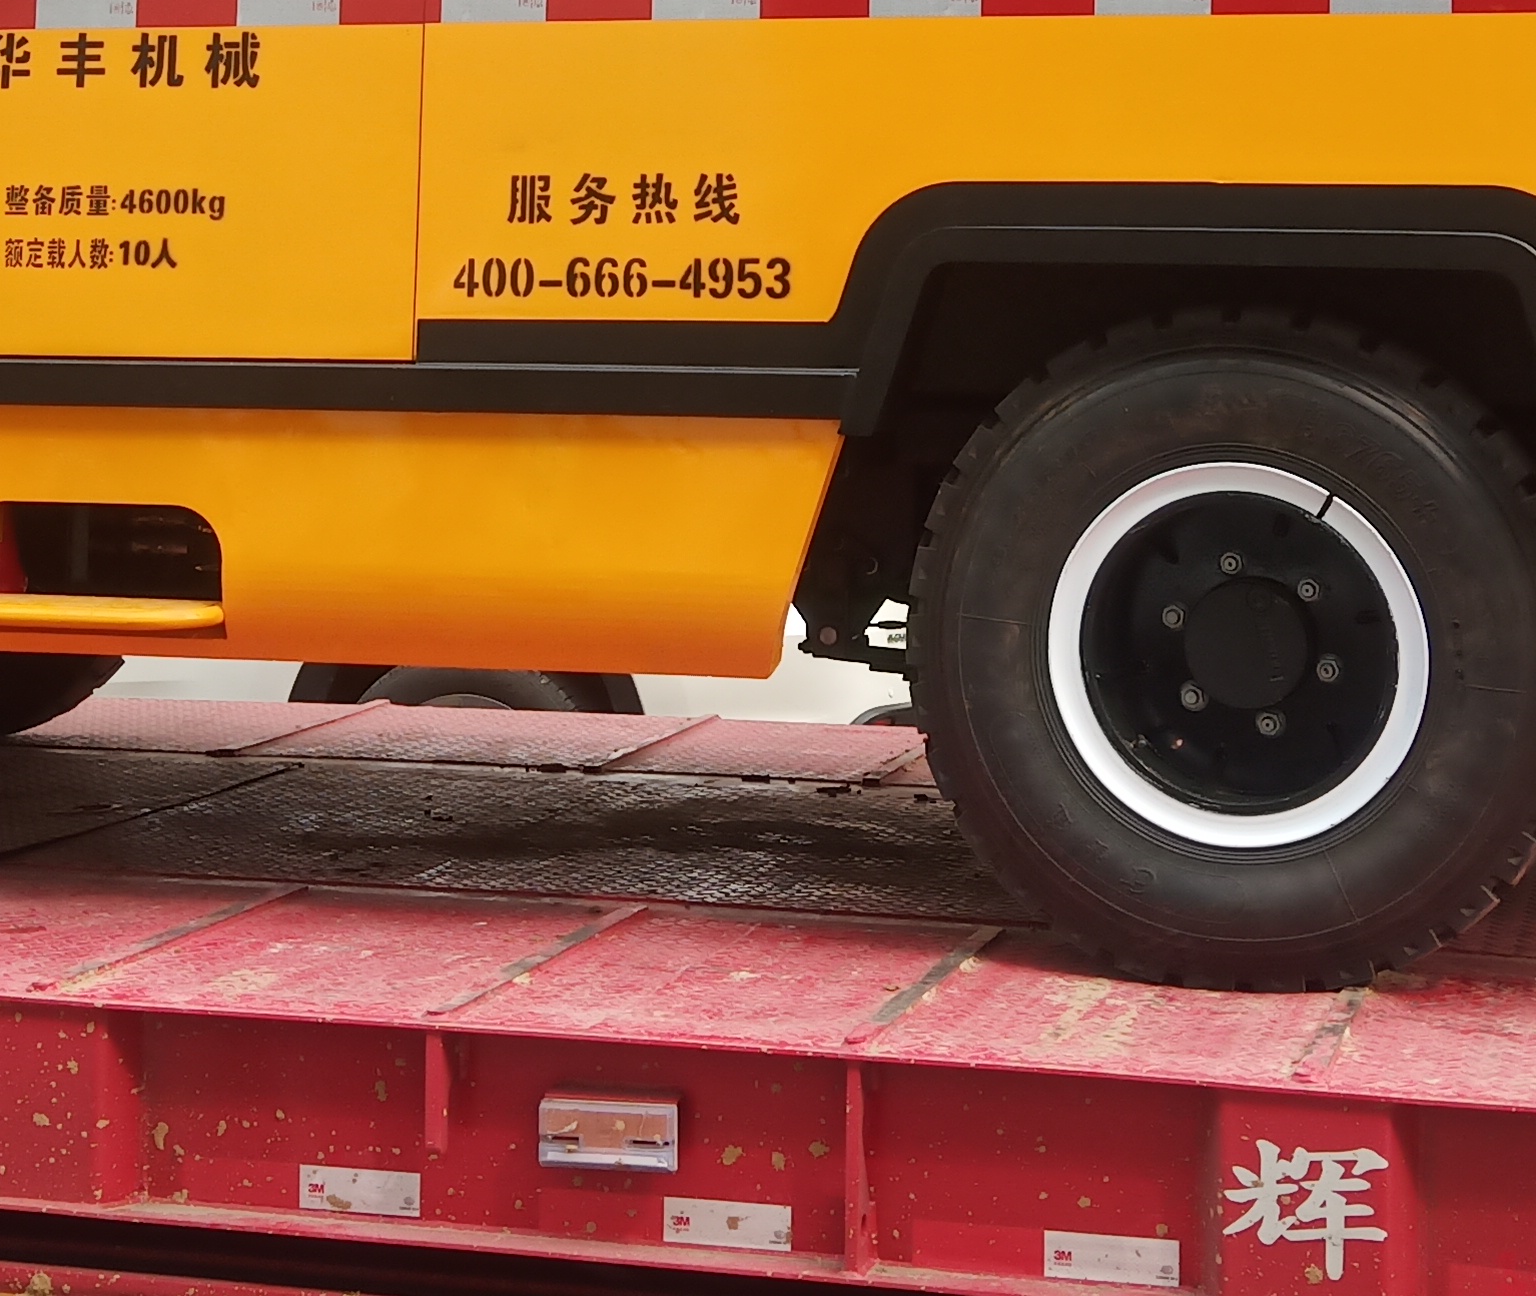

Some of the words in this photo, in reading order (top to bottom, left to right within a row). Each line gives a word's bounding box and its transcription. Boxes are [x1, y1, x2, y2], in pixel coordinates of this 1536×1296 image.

[507, 172, 740, 225] 服务热线
[453, 256, 792, 299] 400-666-4953
[307, 1183, 325, 1194] 3M
[672, 1215, 690, 1226] 3M
[1222, 1139, 1389, 1281] 辉
[1053, 1249, 1072, 1261] 3M
